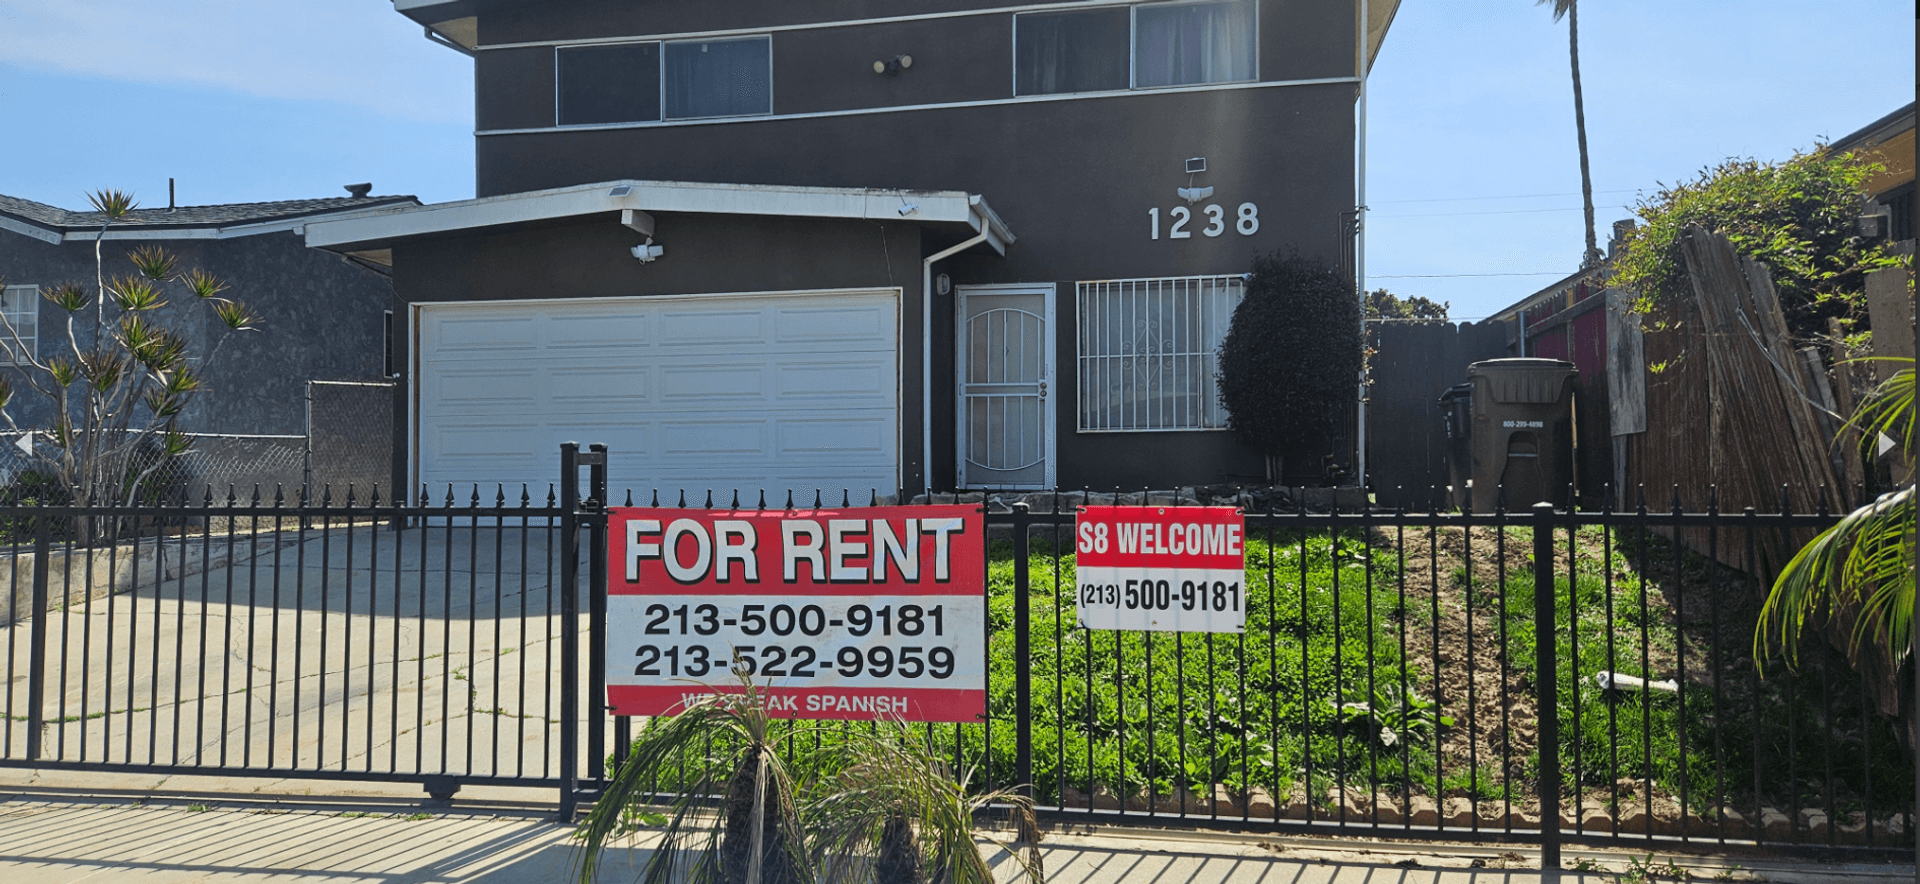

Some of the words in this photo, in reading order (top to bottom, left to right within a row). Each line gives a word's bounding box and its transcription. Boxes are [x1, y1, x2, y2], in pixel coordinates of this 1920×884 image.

[1148, 202, 1259, 240] 1238
[625, 518, 759, 585] FOR
[781, 517, 965, 585] RENT
[1079, 521, 1108, 554] S8
[1116, 522, 1241, 556] WELCOME
[1080, 583, 1121, 610] (213)
[1125, 579, 1239, 612] 500-9181
[644, 603, 944, 637] 213-500-9181
[634, 644, 955, 679] 213-522-9959
[806, 695, 908, 713] SPANISH
